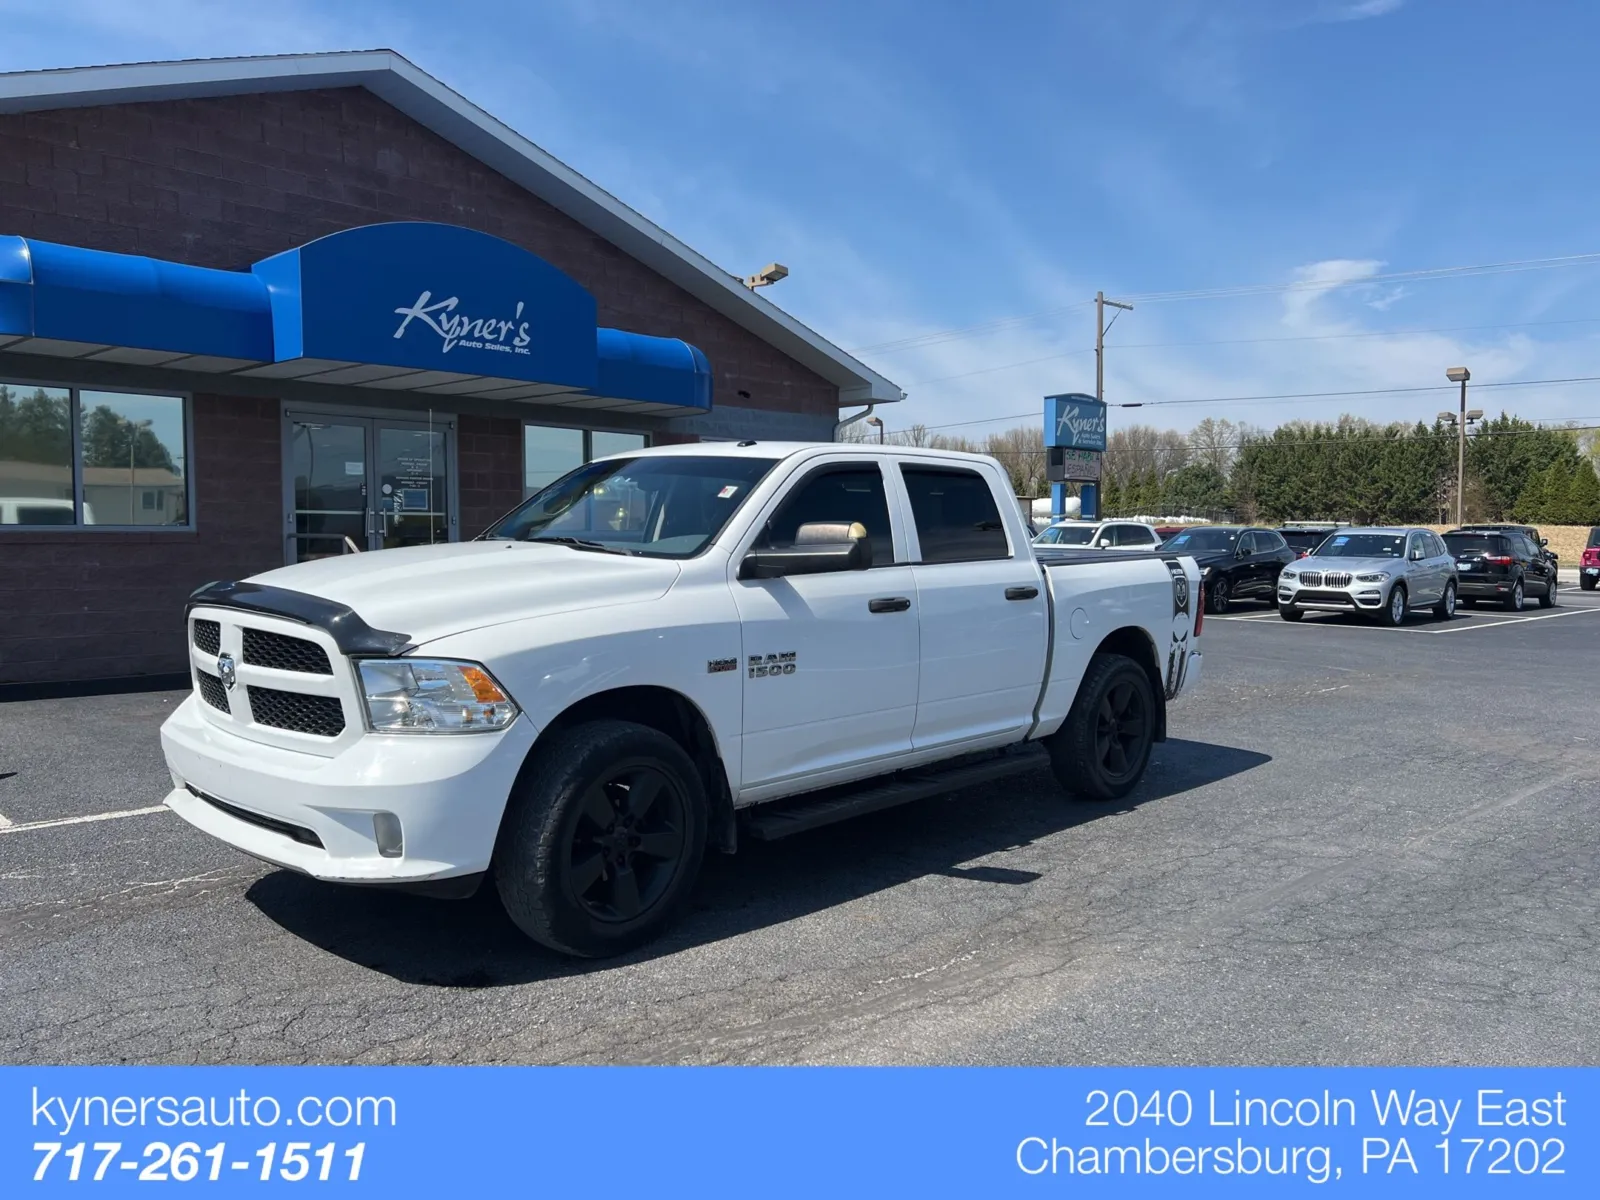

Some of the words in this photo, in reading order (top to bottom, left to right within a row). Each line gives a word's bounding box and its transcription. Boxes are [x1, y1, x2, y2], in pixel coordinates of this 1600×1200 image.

[393, 290, 531, 353] Kyner's
[458, 339, 483, 349] Auto
[484, 342, 513, 354] Sales,
[514, 346, 531, 355] Inc.
[1057, 404, 1105, 446] Kyner's
[748, 651, 797, 666] RAM
[748, 663, 797, 678] 1500
